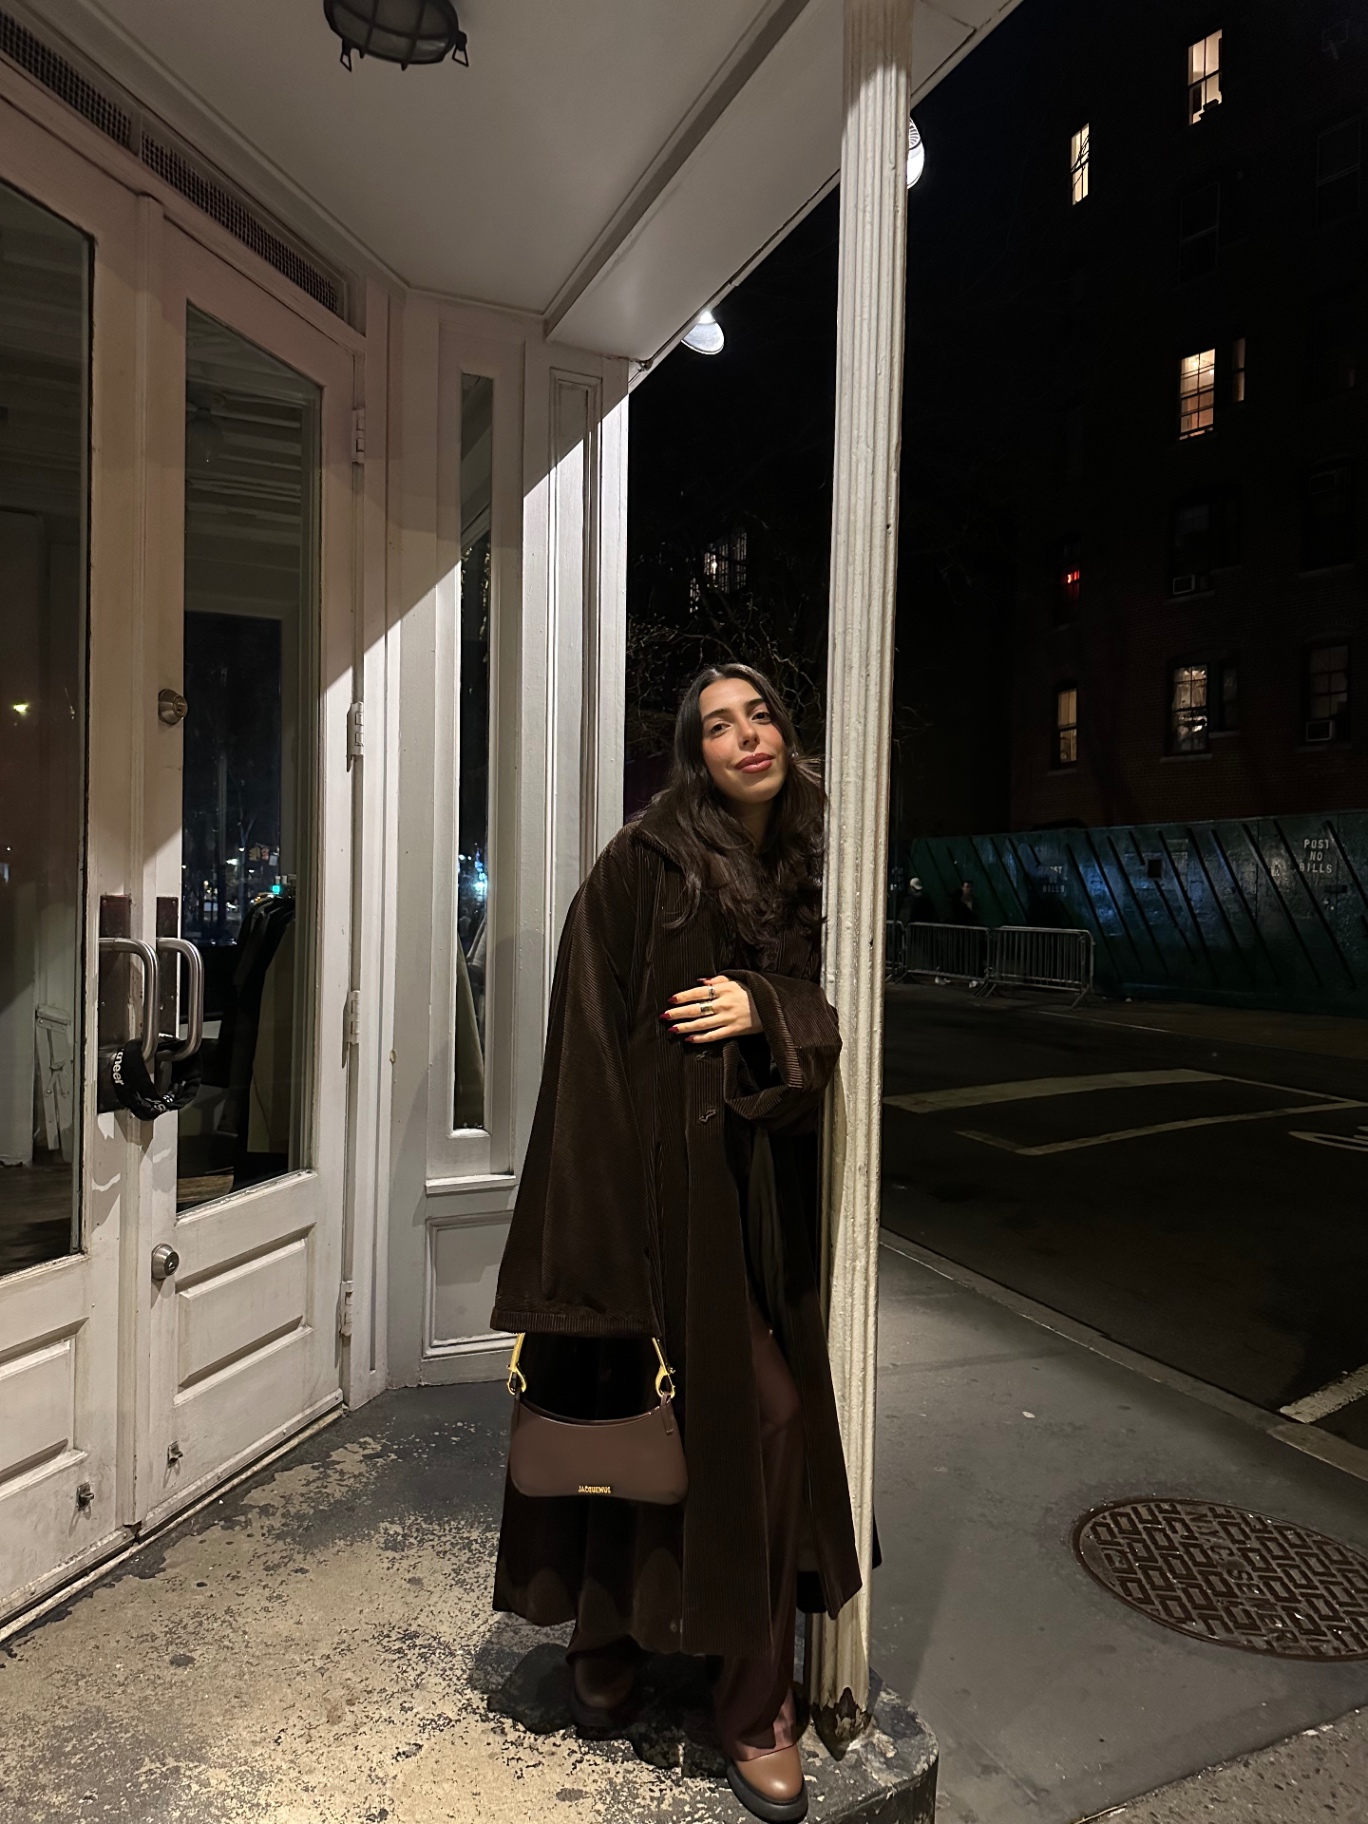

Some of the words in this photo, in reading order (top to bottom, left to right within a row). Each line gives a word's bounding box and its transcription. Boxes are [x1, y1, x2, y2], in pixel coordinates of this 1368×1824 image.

[1304, 838, 1329, 849] POST
[1310, 851, 1323, 861] NO
[1300, 862, 1332, 874] BILLS
[1226, 1568, 1300, 1643] SEWER
